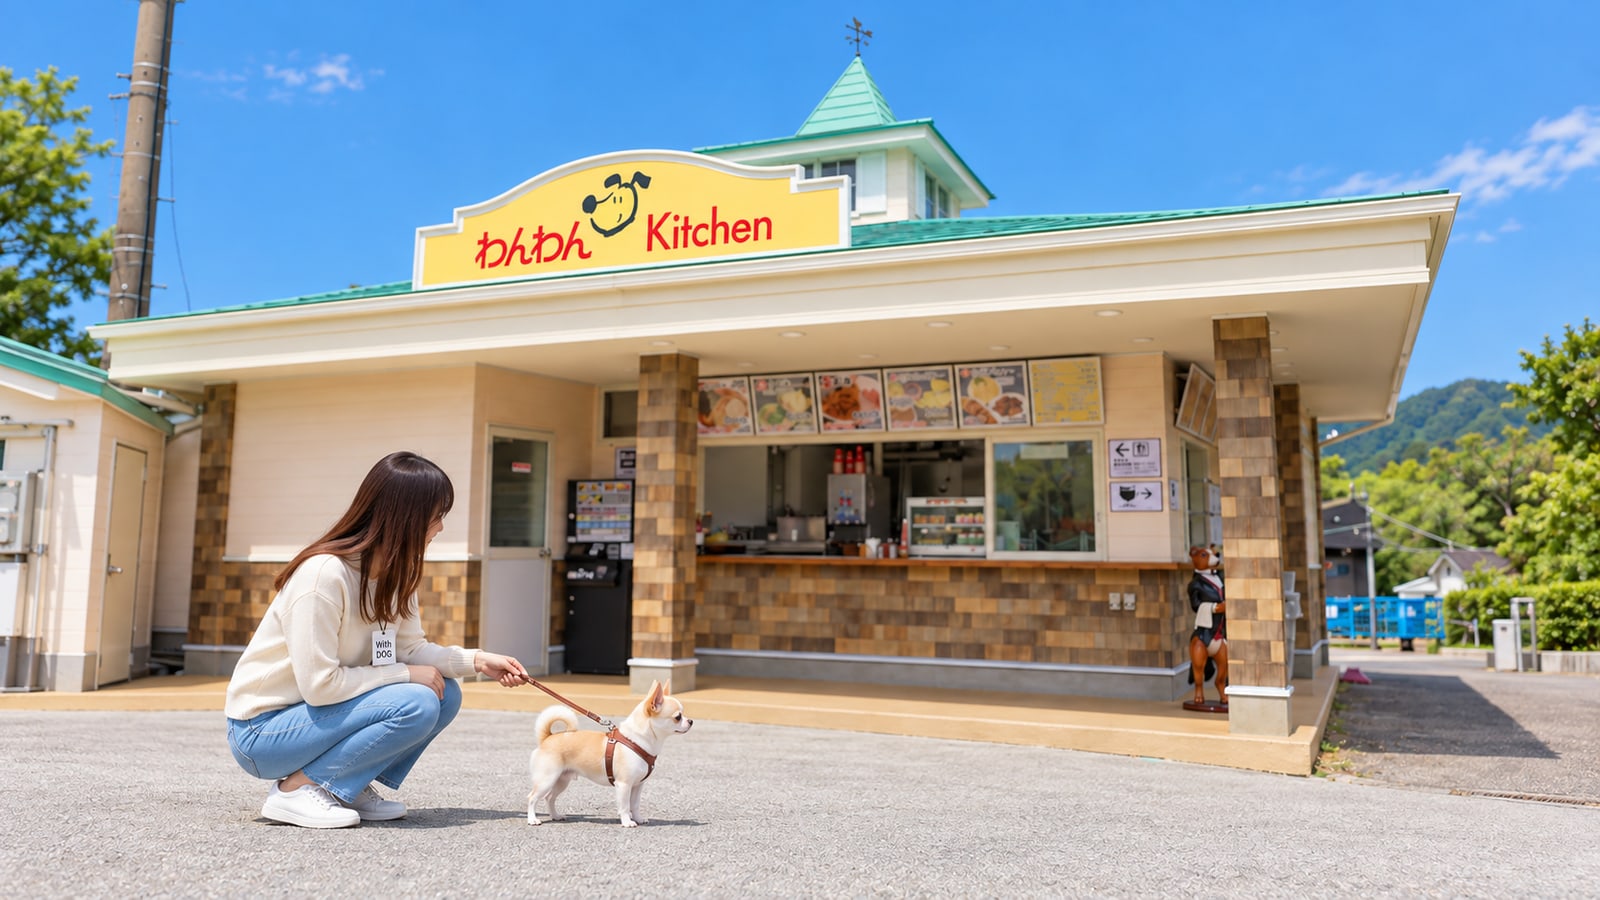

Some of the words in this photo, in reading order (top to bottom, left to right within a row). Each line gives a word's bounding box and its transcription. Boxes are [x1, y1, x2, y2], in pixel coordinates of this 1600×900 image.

[475, 221, 593, 269] わんわん
[646, 205, 772, 252] Kitchen
[376, 640, 392, 649] With
[376, 650, 393, 659] DOG
